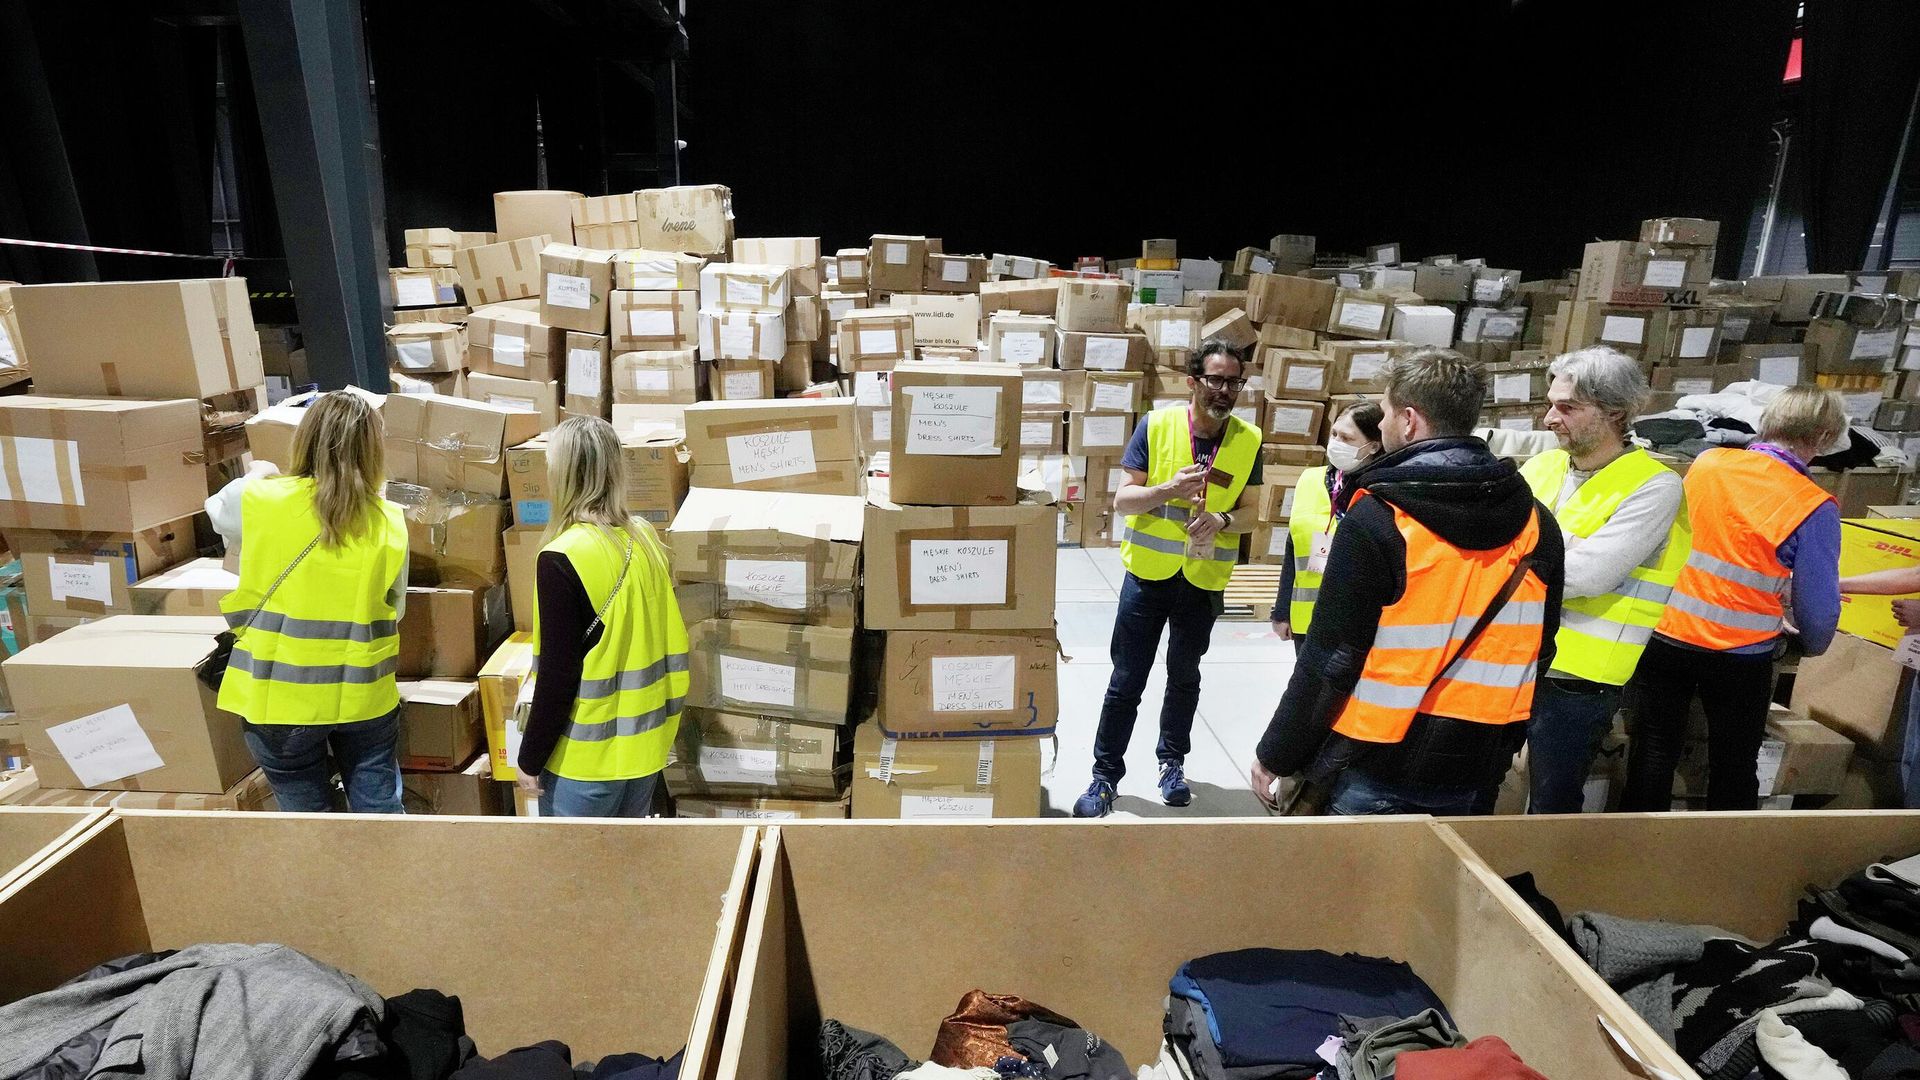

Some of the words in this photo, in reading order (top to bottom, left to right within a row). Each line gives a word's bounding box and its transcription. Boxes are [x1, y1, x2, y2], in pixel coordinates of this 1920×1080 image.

[661, 217, 697, 232] Irene
[1663, 290, 1700, 305] XXL
[933, 402, 969, 411] KOSZULE
[917, 433, 943, 441] DRESS
[738, 462, 766, 474] MEN'S
[522, 482, 541, 494] Slip
[957, 546, 995, 556] KOSZULE
[1875, 541, 1912, 558] DHL
[942, 661, 993, 671] KOSZULE
[947, 687, 980, 700] MEN'S
[938, 702, 967, 711] DRESS
[971, 700, 1004, 710] SHIRTS
[901, 731, 940, 739] IKEA
